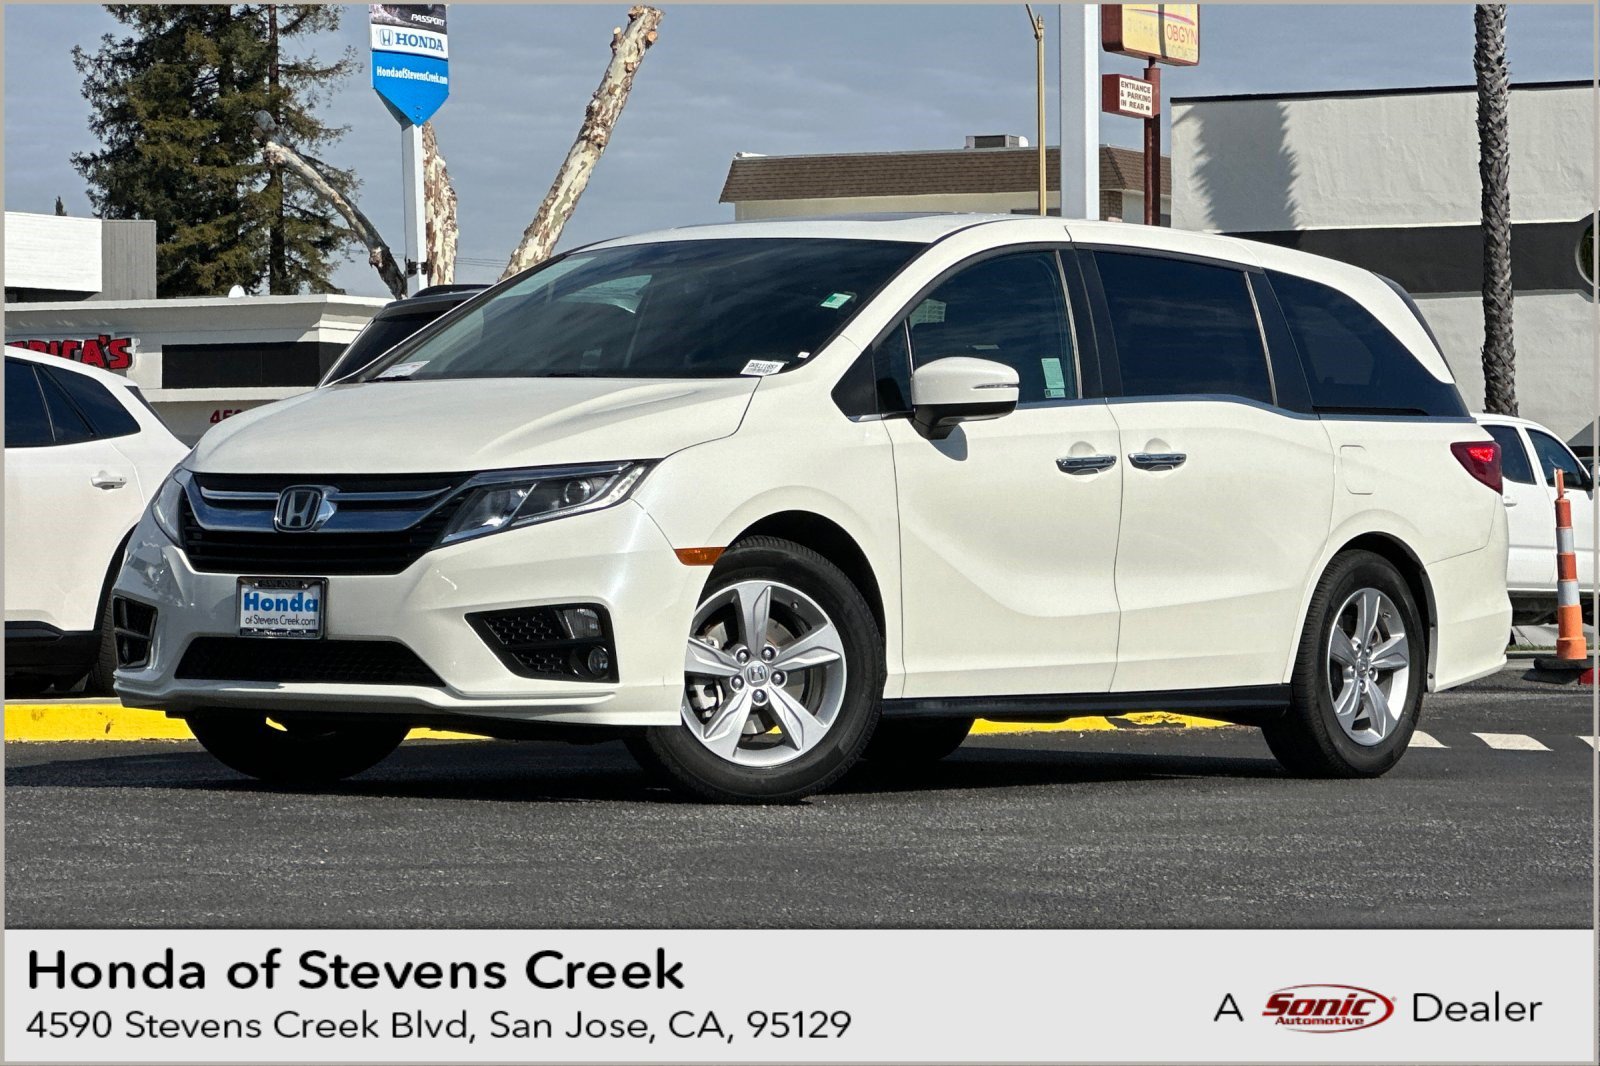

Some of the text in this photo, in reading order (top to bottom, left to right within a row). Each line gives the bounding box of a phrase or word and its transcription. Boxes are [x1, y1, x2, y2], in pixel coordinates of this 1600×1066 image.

[411, 14, 445, 26] PASSPORT
[1166, 24, 1197, 44] OBGYN
[395, 33, 445, 52] HONDA
[1121, 81, 1151, 94] ENTRANCE
[1127, 91, 1151, 103] PARKING
[1129, 101, 1145, 111] REAR
[244, 592, 318, 612] Honda
[245, 614, 316, 626] of Stevens Creek.com
